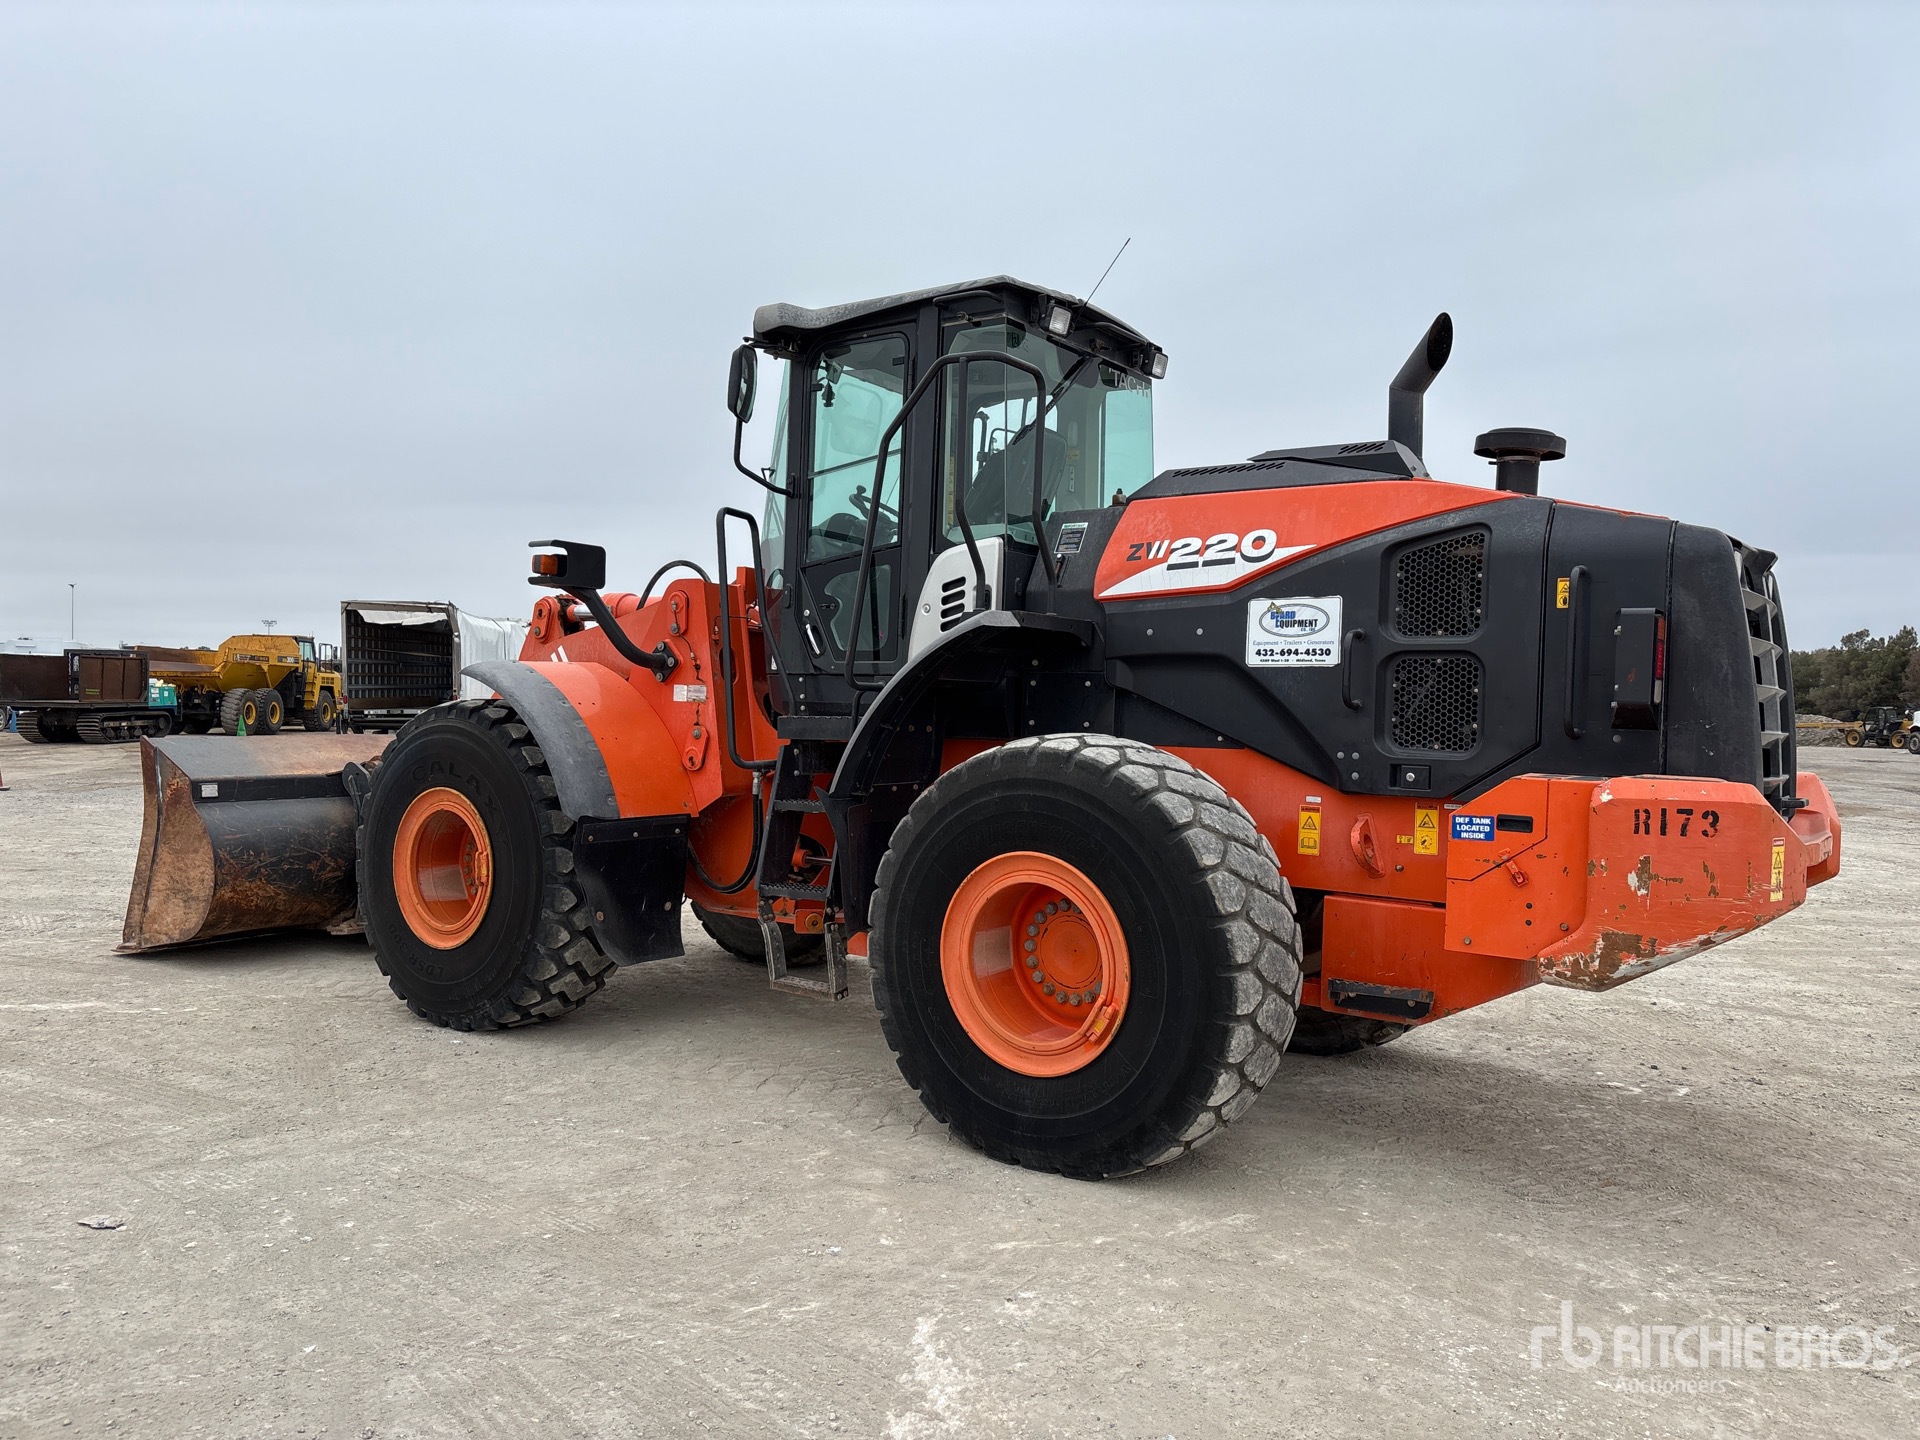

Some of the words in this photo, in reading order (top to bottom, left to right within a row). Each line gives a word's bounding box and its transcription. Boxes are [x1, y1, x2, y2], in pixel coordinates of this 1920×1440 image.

[1275, 618, 1318, 628] EQUIPMENT
[1255, 648, 1331, 656] 432-694-4530
[1455, 816, 1470, 824] DEF
[1471, 817, 1491, 825] TANK
[1633, 808, 1720, 838] R173
[1456, 824, 1490, 832] LOCATED
